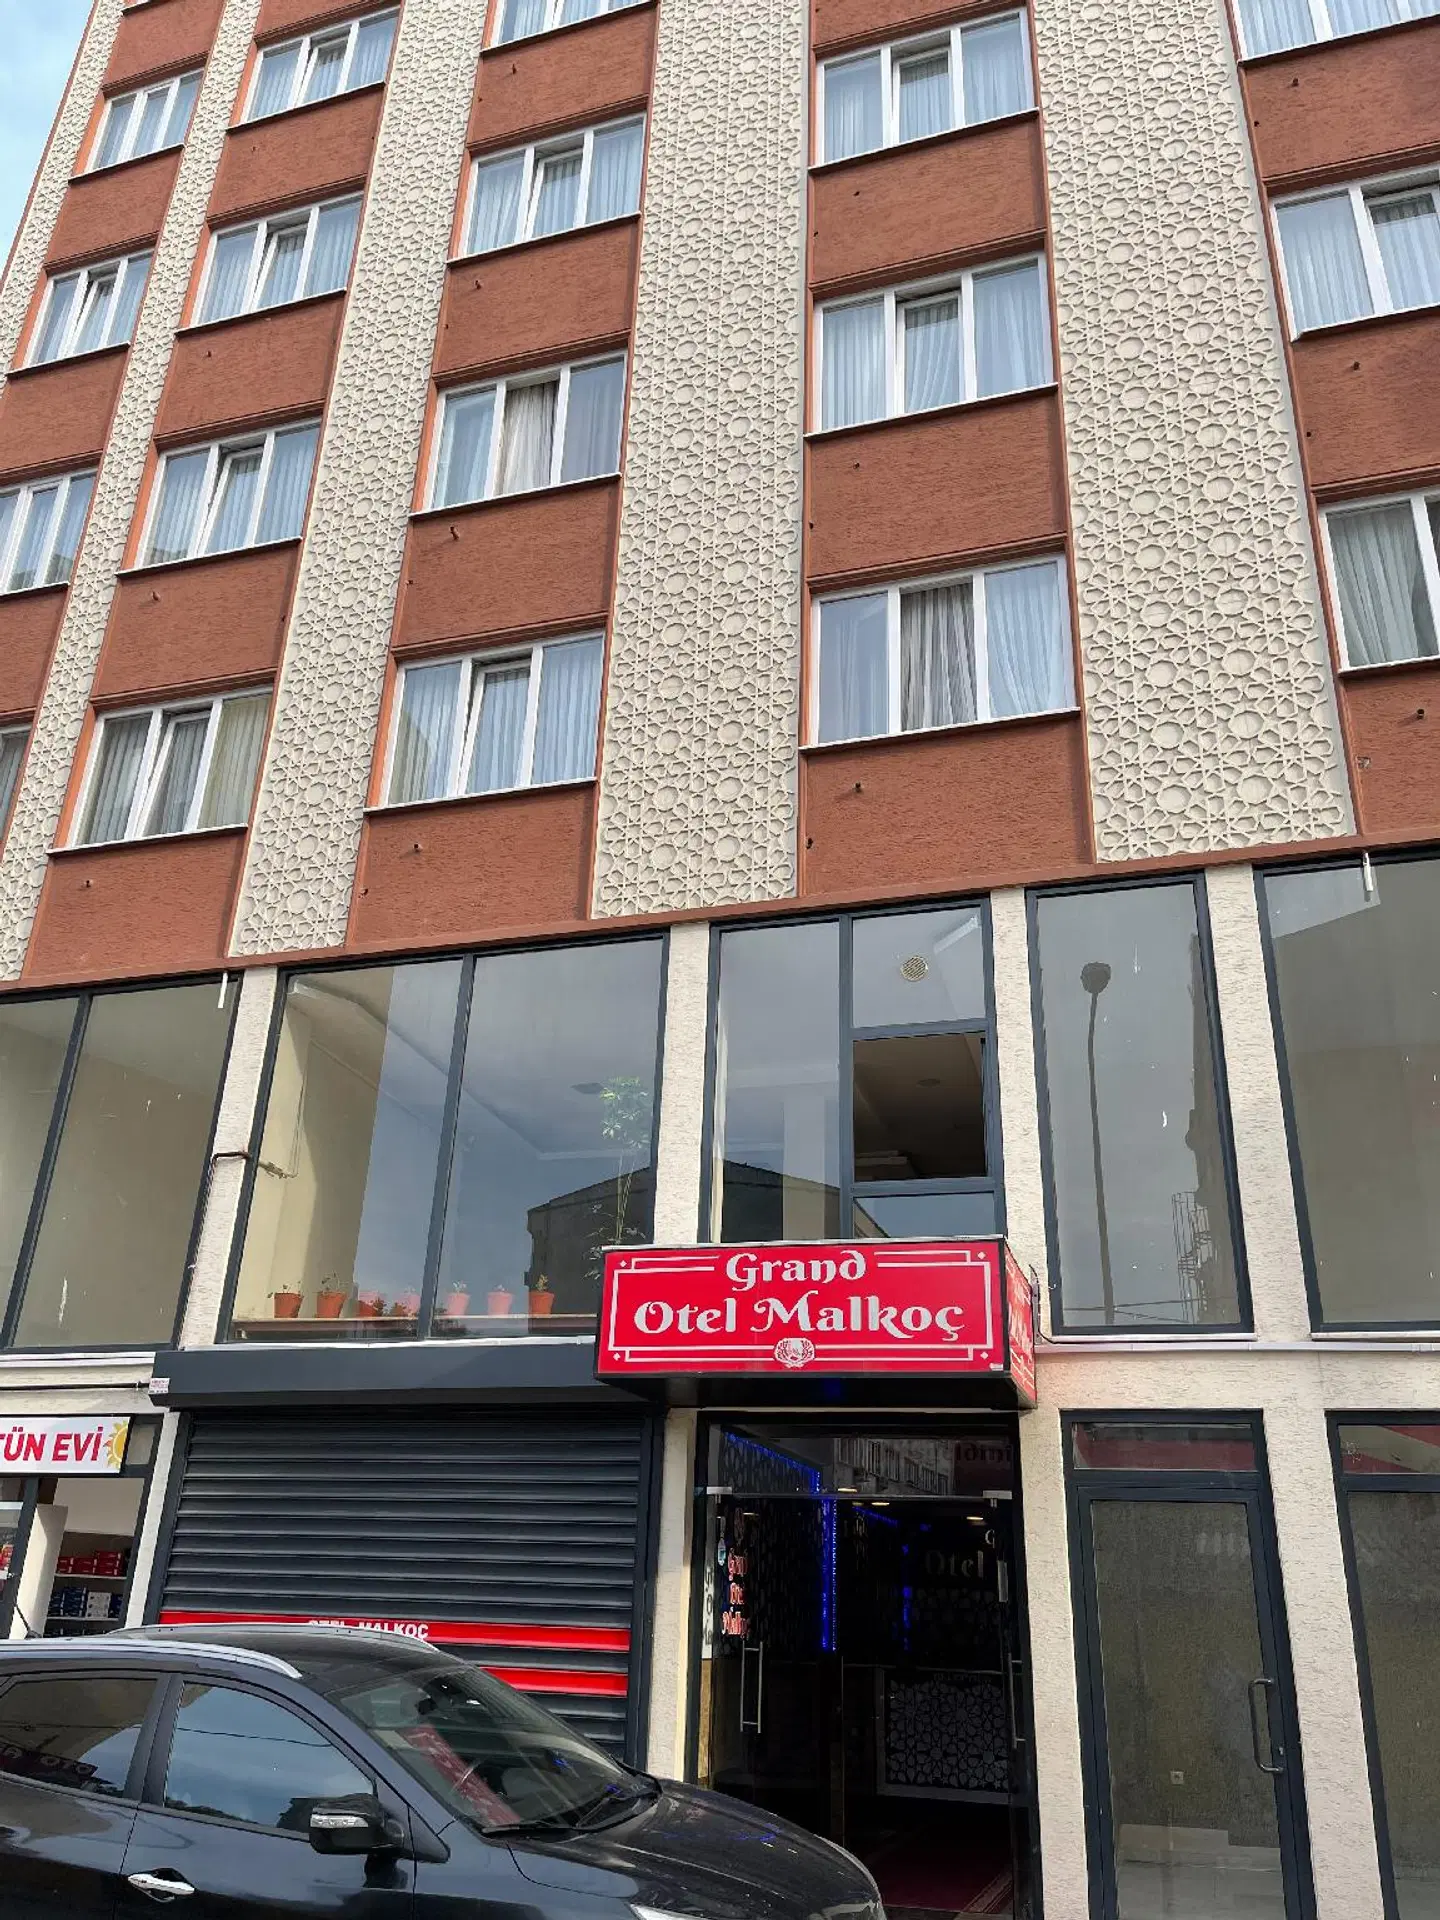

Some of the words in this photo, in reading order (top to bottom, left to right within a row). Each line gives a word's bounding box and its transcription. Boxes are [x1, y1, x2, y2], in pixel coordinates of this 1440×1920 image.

[726, 1250, 867, 1292] Grand
[633, 1296, 737, 1335] Otel
[750, 1289, 966, 1342] Malkoç
[51, 1426, 104, 1462] EVİ
